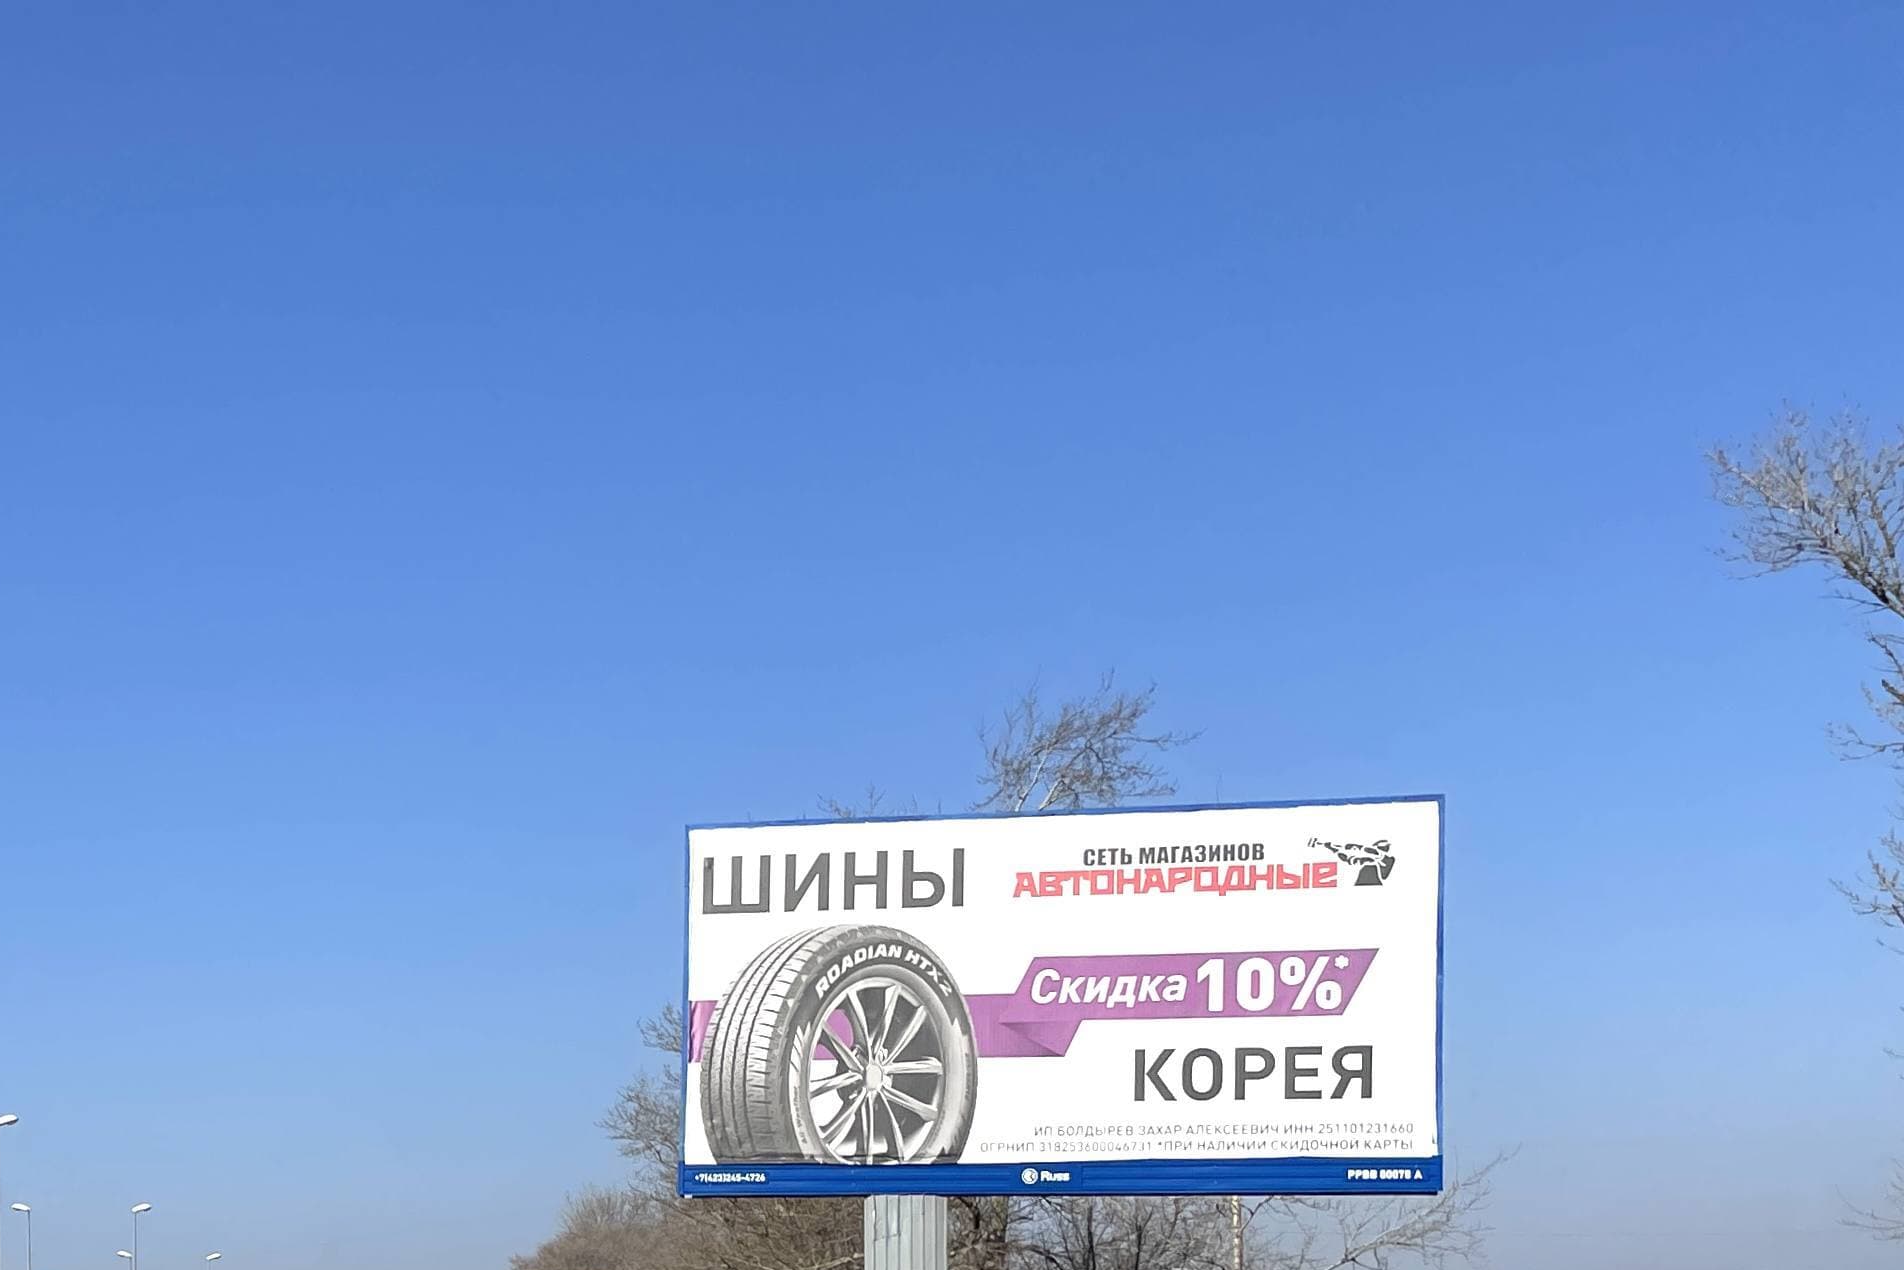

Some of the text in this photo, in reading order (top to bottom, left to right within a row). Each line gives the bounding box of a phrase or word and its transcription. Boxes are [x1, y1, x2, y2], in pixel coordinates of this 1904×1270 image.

[1083, 843, 1265, 867] СЕТЬ МАГАЗИНОВ
[703, 848, 964, 914] ШИНЫ
[1013, 862, 1338, 898] АВТОНАРОДНЫЕ
[815, 943, 903, 1000] ROADIAN
[1030, 968, 1188, 1008] Скидка
[1134, 1045, 1373, 1101] КОРЕЯ
[980, 1142, 1035, 1152] ОГРНИП
[1197, 1139, 1266, 1150] НАЛИЧИИ
[1270, 1138, 1360, 1152] СКИДОЧНОЙ
[1364, 1138, 1413, 1150] КАРТЫ
[1034, 1126, 1053, 1136] ИП
[1057, 1125, 1134, 1138] БОЛДЫРЕВ
[1138, 1125, 1182, 1136] ЗАХАР
[1186, 1124, 1279, 1135] АЛЕКСЕЕВИЧ
[1284, 1123, 1314, 1134] ИНН
